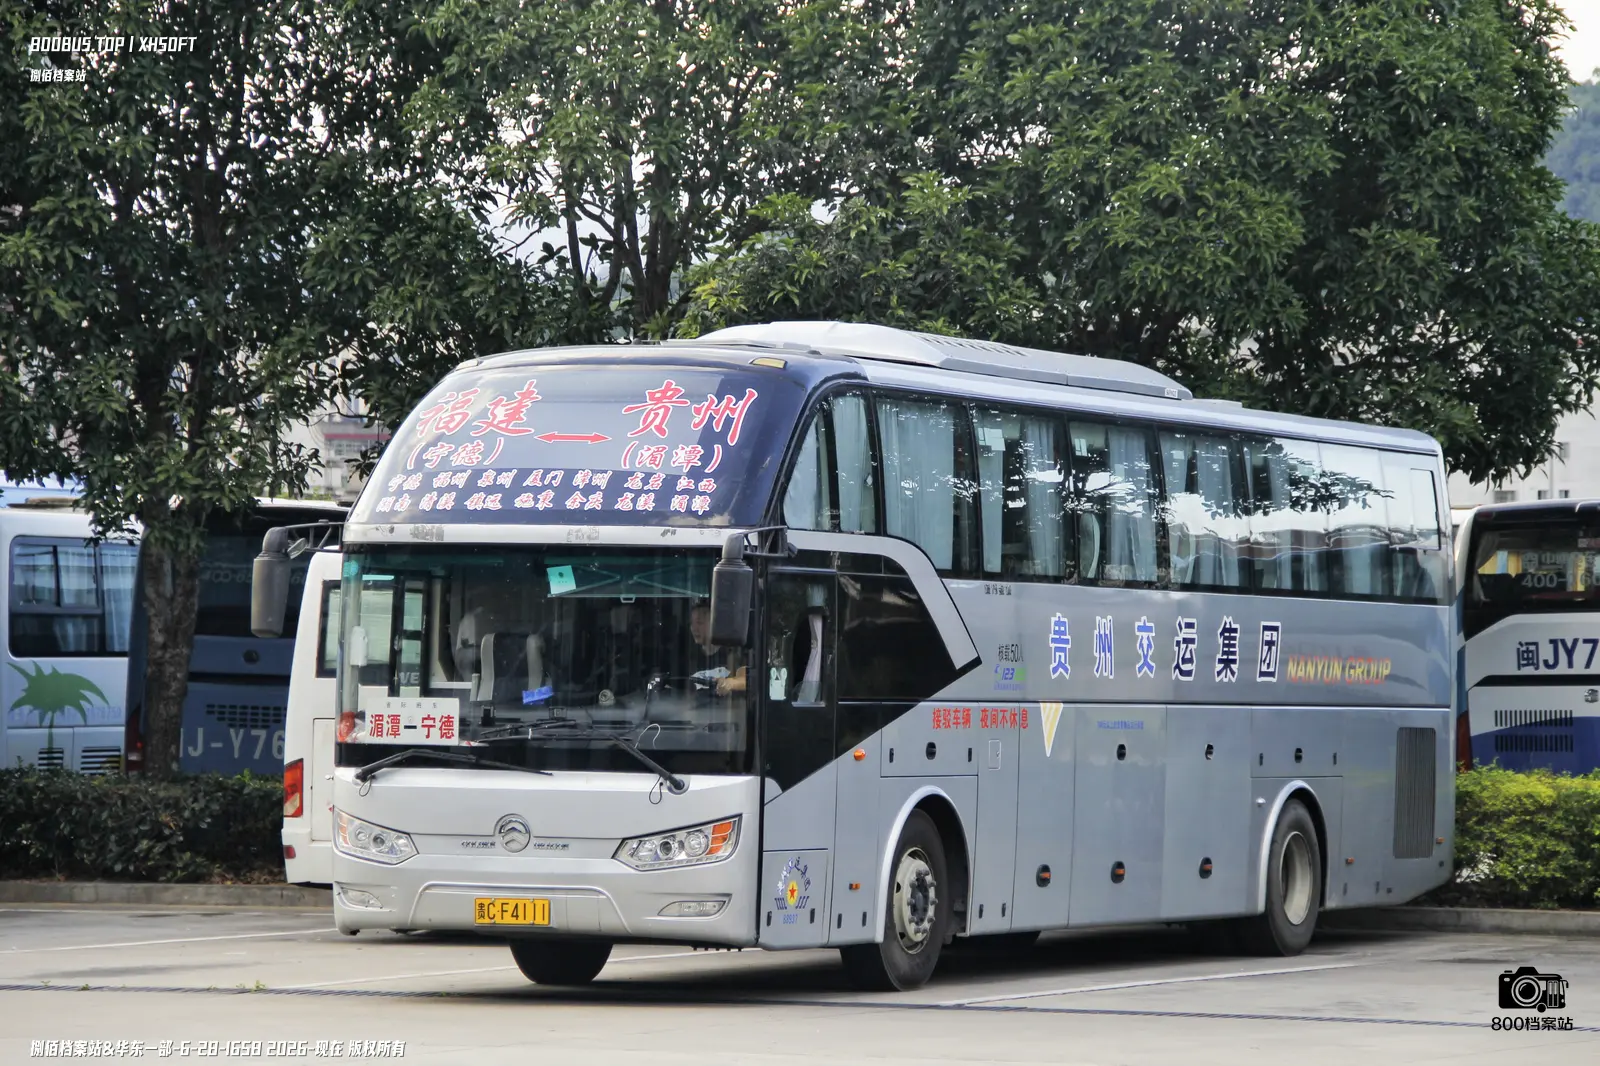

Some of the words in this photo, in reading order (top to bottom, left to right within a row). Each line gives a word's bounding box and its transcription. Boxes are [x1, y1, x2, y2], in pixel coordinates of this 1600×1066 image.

[415, 378, 543, 439] 福建
[621, 378, 759, 447] 贵州
[388, 471, 423, 492] 宁德
[432, 469, 472, 488] 福州
[477, 469, 517, 489] 泉州
[523, 469, 564, 487] 厦门
[572, 469, 612, 489] 漳州
[624, 471, 666, 491] 龙岩
[676, 475, 717, 494] 江西
[376, 492, 412, 513] 湖南
[464, 491, 503, 512] 镇远
[514, 489, 555, 511] 施秉
[564, 490, 604, 511] 余庆
[614, 492, 656, 512] 龙溪
[670, 494, 711, 516] 湄潭
[1048, 612, 1282, 683] 贵州交运集团
[1286, 655, 1342, 684] NANYUN
[1345, 655, 1392, 684] GROUP
[932, 707, 971, 730] 接驳车辆
[980, 708, 1029, 730] 夜间不休息
[179, 726, 285, 760] J-Y76
